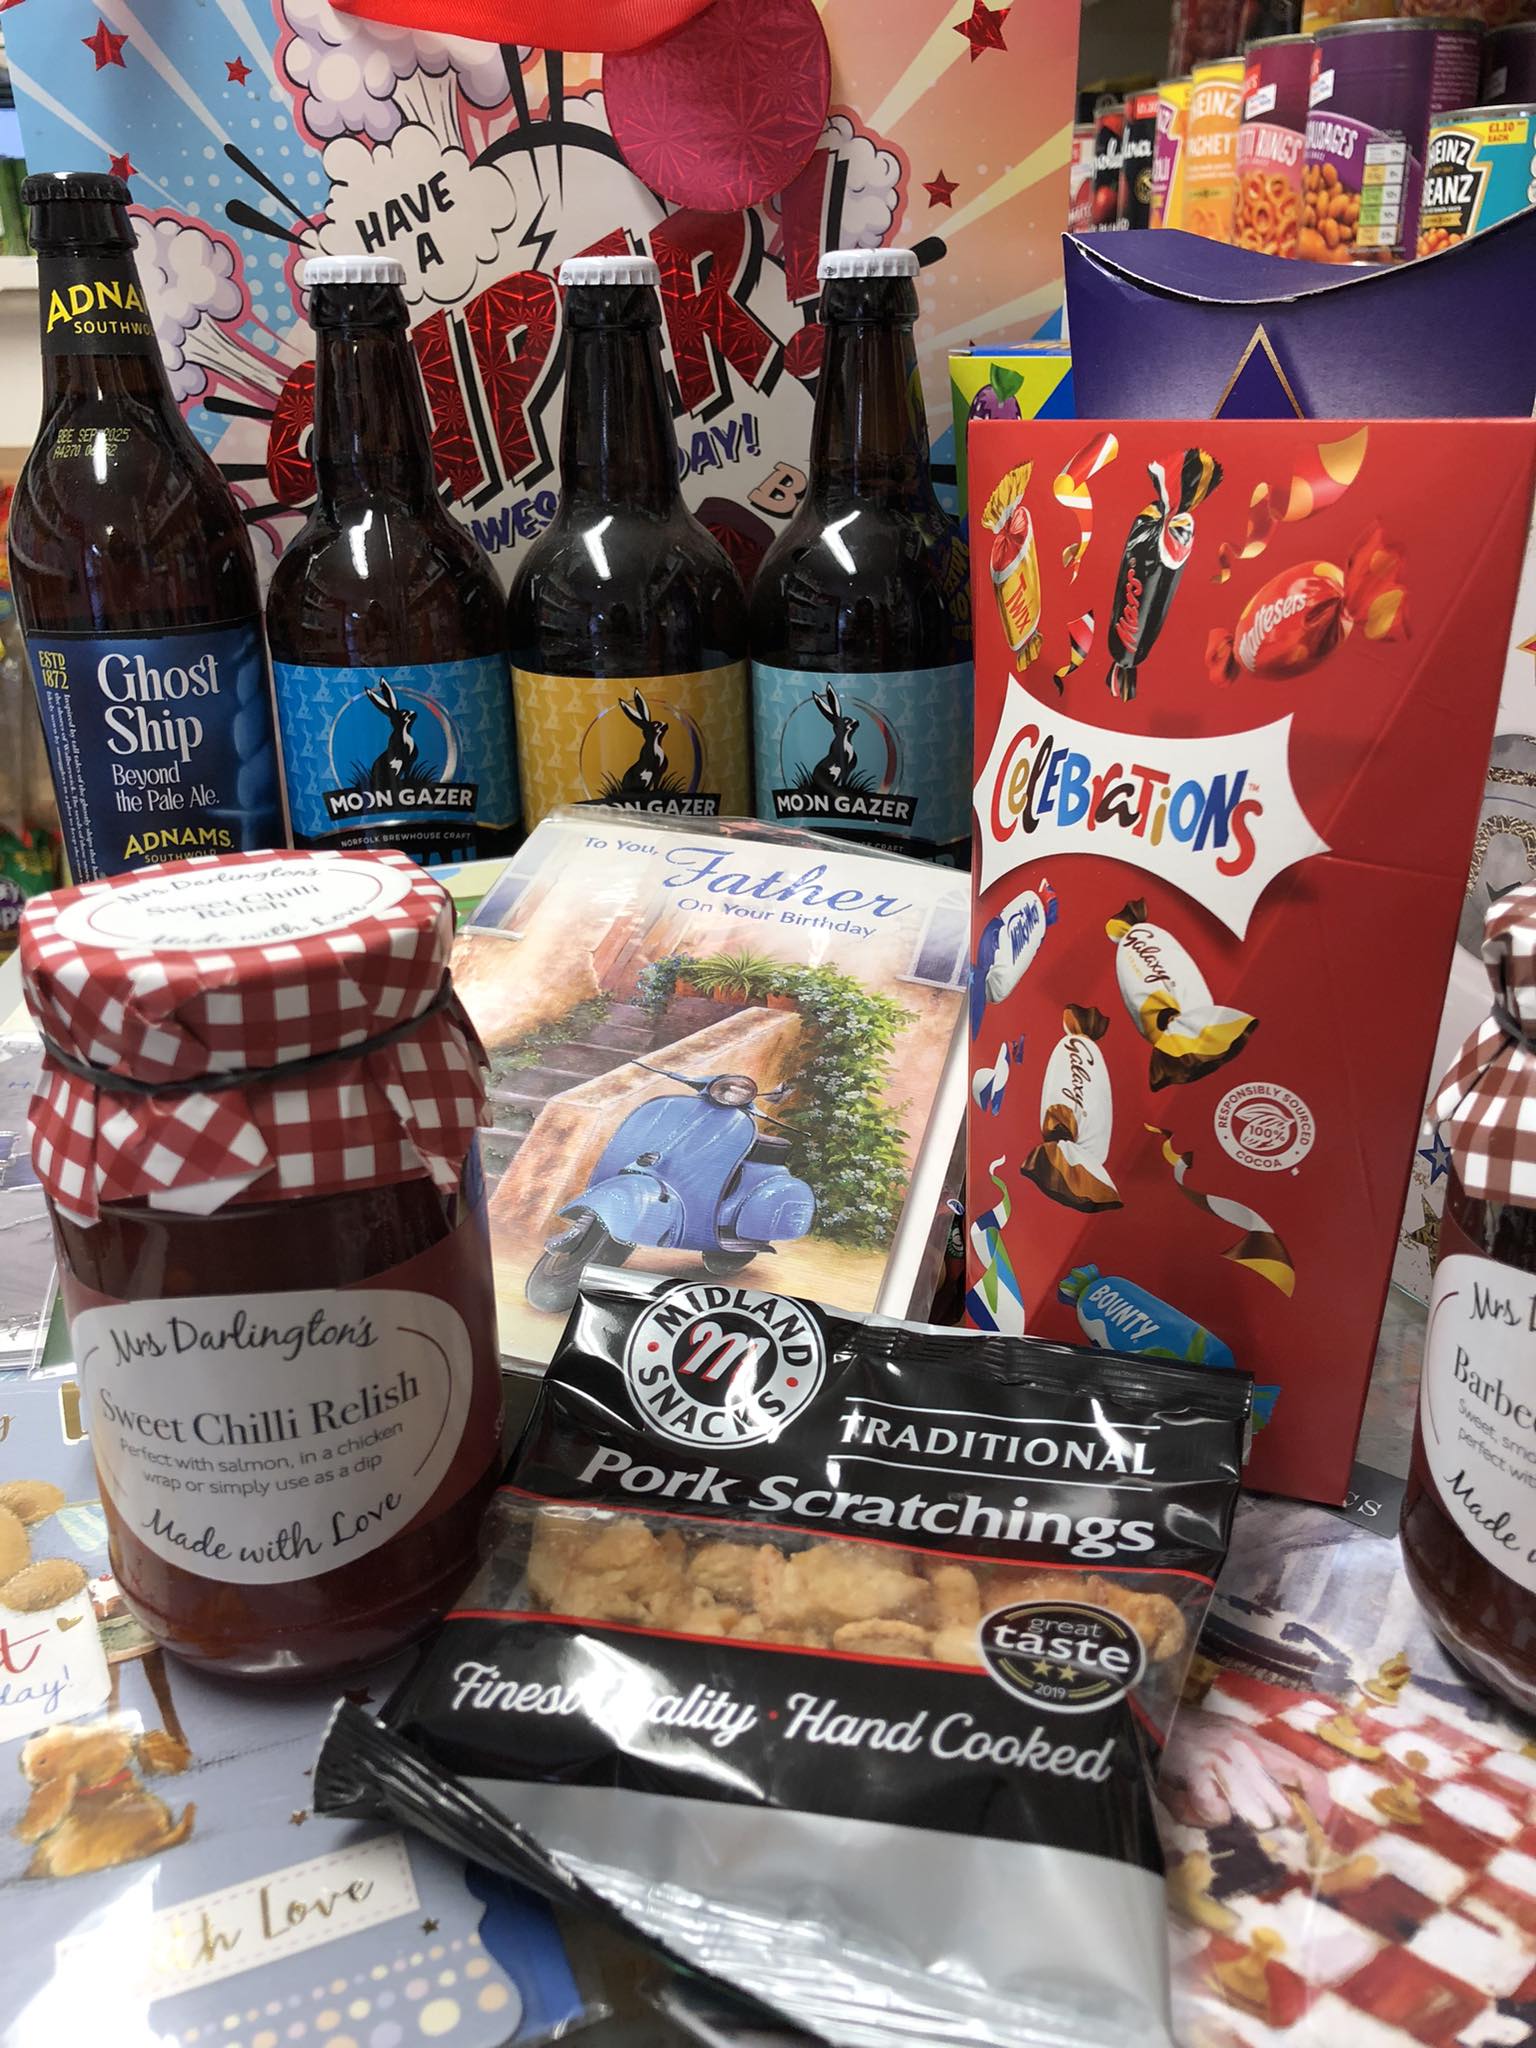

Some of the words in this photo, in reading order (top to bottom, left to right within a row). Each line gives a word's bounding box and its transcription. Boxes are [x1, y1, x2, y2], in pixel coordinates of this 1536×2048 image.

[357, 171, 456, 253] HAVE
[416, 233, 444, 273] A
[46, 280, 149, 334] ADNA
[78, 427, 98, 443] SEP
[42, 669, 69, 690] 1872
[97, 653, 222, 703] Ghost
[104, 705, 204, 763] Ship
[112, 760, 181, 790] Beyond
[116, 791, 143, 813] the
[148, 788, 186, 812] Pale
[189, 783, 221, 809] Ale.
[329, 789, 393, 815] MOON
[398, 788, 473, 807] GAZER
[647, 799, 715, 817] GAZER
[777, 794, 829, 812] MOON
[834, 796, 911, 820] GAZER
[341, 835, 380, 848] NORFOLK
[382, 832, 441, 843] BREWHOUSE
[443, 832, 471, 840] CRAFT
[585, 837, 607, 850] To
[663, 846, 913, 918] Father
[678, 898, 713, 913] On
[723, 903, 774, 921] Your
[779, 911, 878, 939] Birthday
[1123, 929, 1171, 984] Galaxy
[1061, 1037, 1095, 1109] Galaxy
[1218, 1085, 1282, 1129] RESPONSIBLY
[1281, 1093, 1312, 1146] SOURCED
[1249, 1125, 1286, 1142] 100%
[1235, 1150, 1283, 1168] COCOA
[653, 1286, 813, 1368] MIDLAND
[1088, 1284, 1161, 1343] BOUNTY
[1468, 1281, 1522, 1327] Mrs
[110, 1327, 166, 1367] Mrs
[168, 1307, 378, 1362] Darlington's
[99, 1386, 187, 1445] Sweet
[193, 1407, 300, 1447] Chilli
[312, 1370, 421, 1436] Relish
[638, 1364, 787, 1438] SNACKS
[120, 1437, 172, 1468] Perfect
[174, 1456, 214, 1473] with
[217, 1457, 295, 1473] salmon,
[300, 1451, 317, 1465] in
[322, 1448, 333, 1460] a
[337, 1421, 404, 1456] chicken
[839, 1408, 1156, 1477] TRADITIONAL
[143, 1471, 181, 1493] wrap
[185, 1480, 206, 1493] or
[209, 1480, 270, 1498] simply
[276, 1475, 310, 1492] use
[314, 1469, 335, 1485] as
[339, 1466, 350, 1478] a
[354, 1454, 383, 1474] dip
[576, 1444, 742, 1504] Pork
[749, 1471, 1157, 1559] Scratchings
[142, 1507, 232, 1562] Made
[240, 1520, 323, 1565] with
[331, 1492, 402, 1548] Love
[1443, 1469, 1520, 1551] Made
[993, 1624, 1131, 1674] taste
[1027, 1618, 1102, 1638] great
[1034, 1682, 1067, 1698] 2019
[784, 1691, 924, 1754] Hand
[929, 1711, 1116, 1784] Cooked
[259, 1880, 375, 1941] Love
